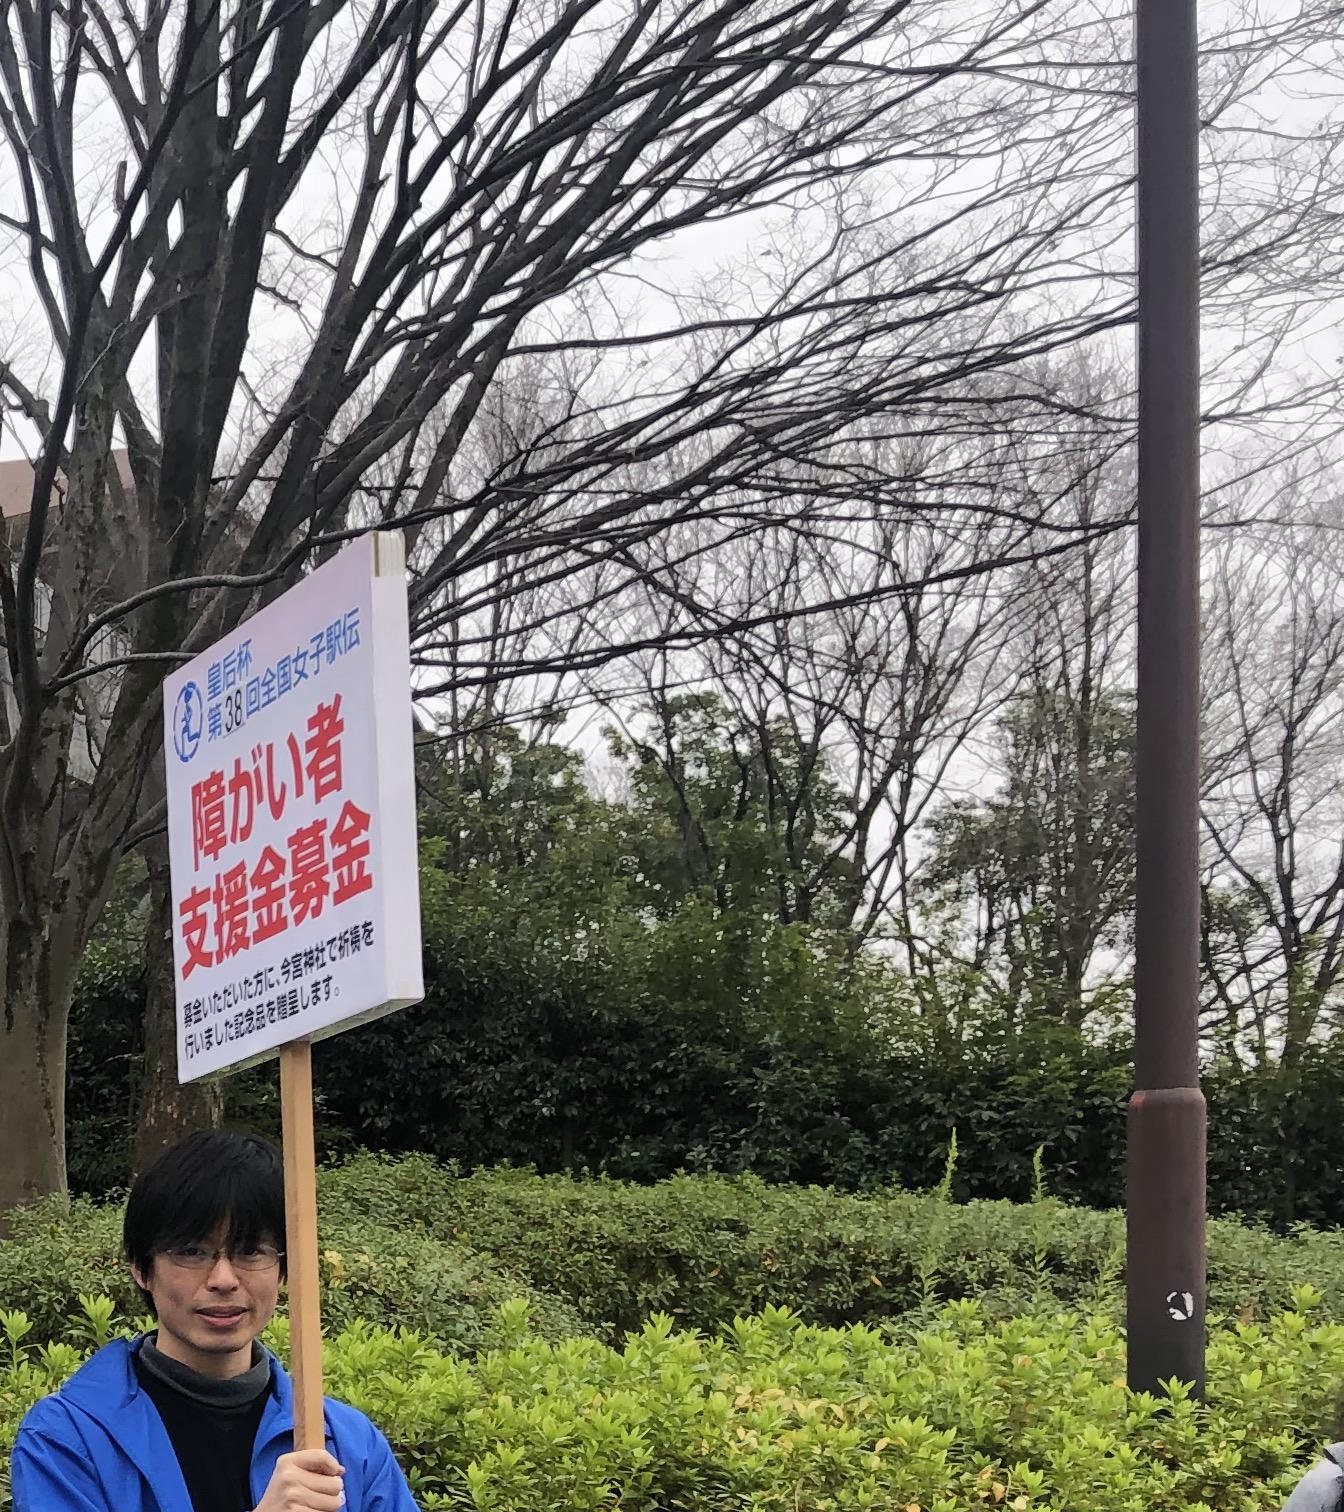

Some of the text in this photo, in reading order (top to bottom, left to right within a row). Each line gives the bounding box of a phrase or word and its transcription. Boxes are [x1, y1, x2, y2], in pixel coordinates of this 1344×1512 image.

[208, 638, 252, 701] 皇后杯
[191, 693, 345, 872] 障がい者
[180, 800, 373, 980] 支援金募金
